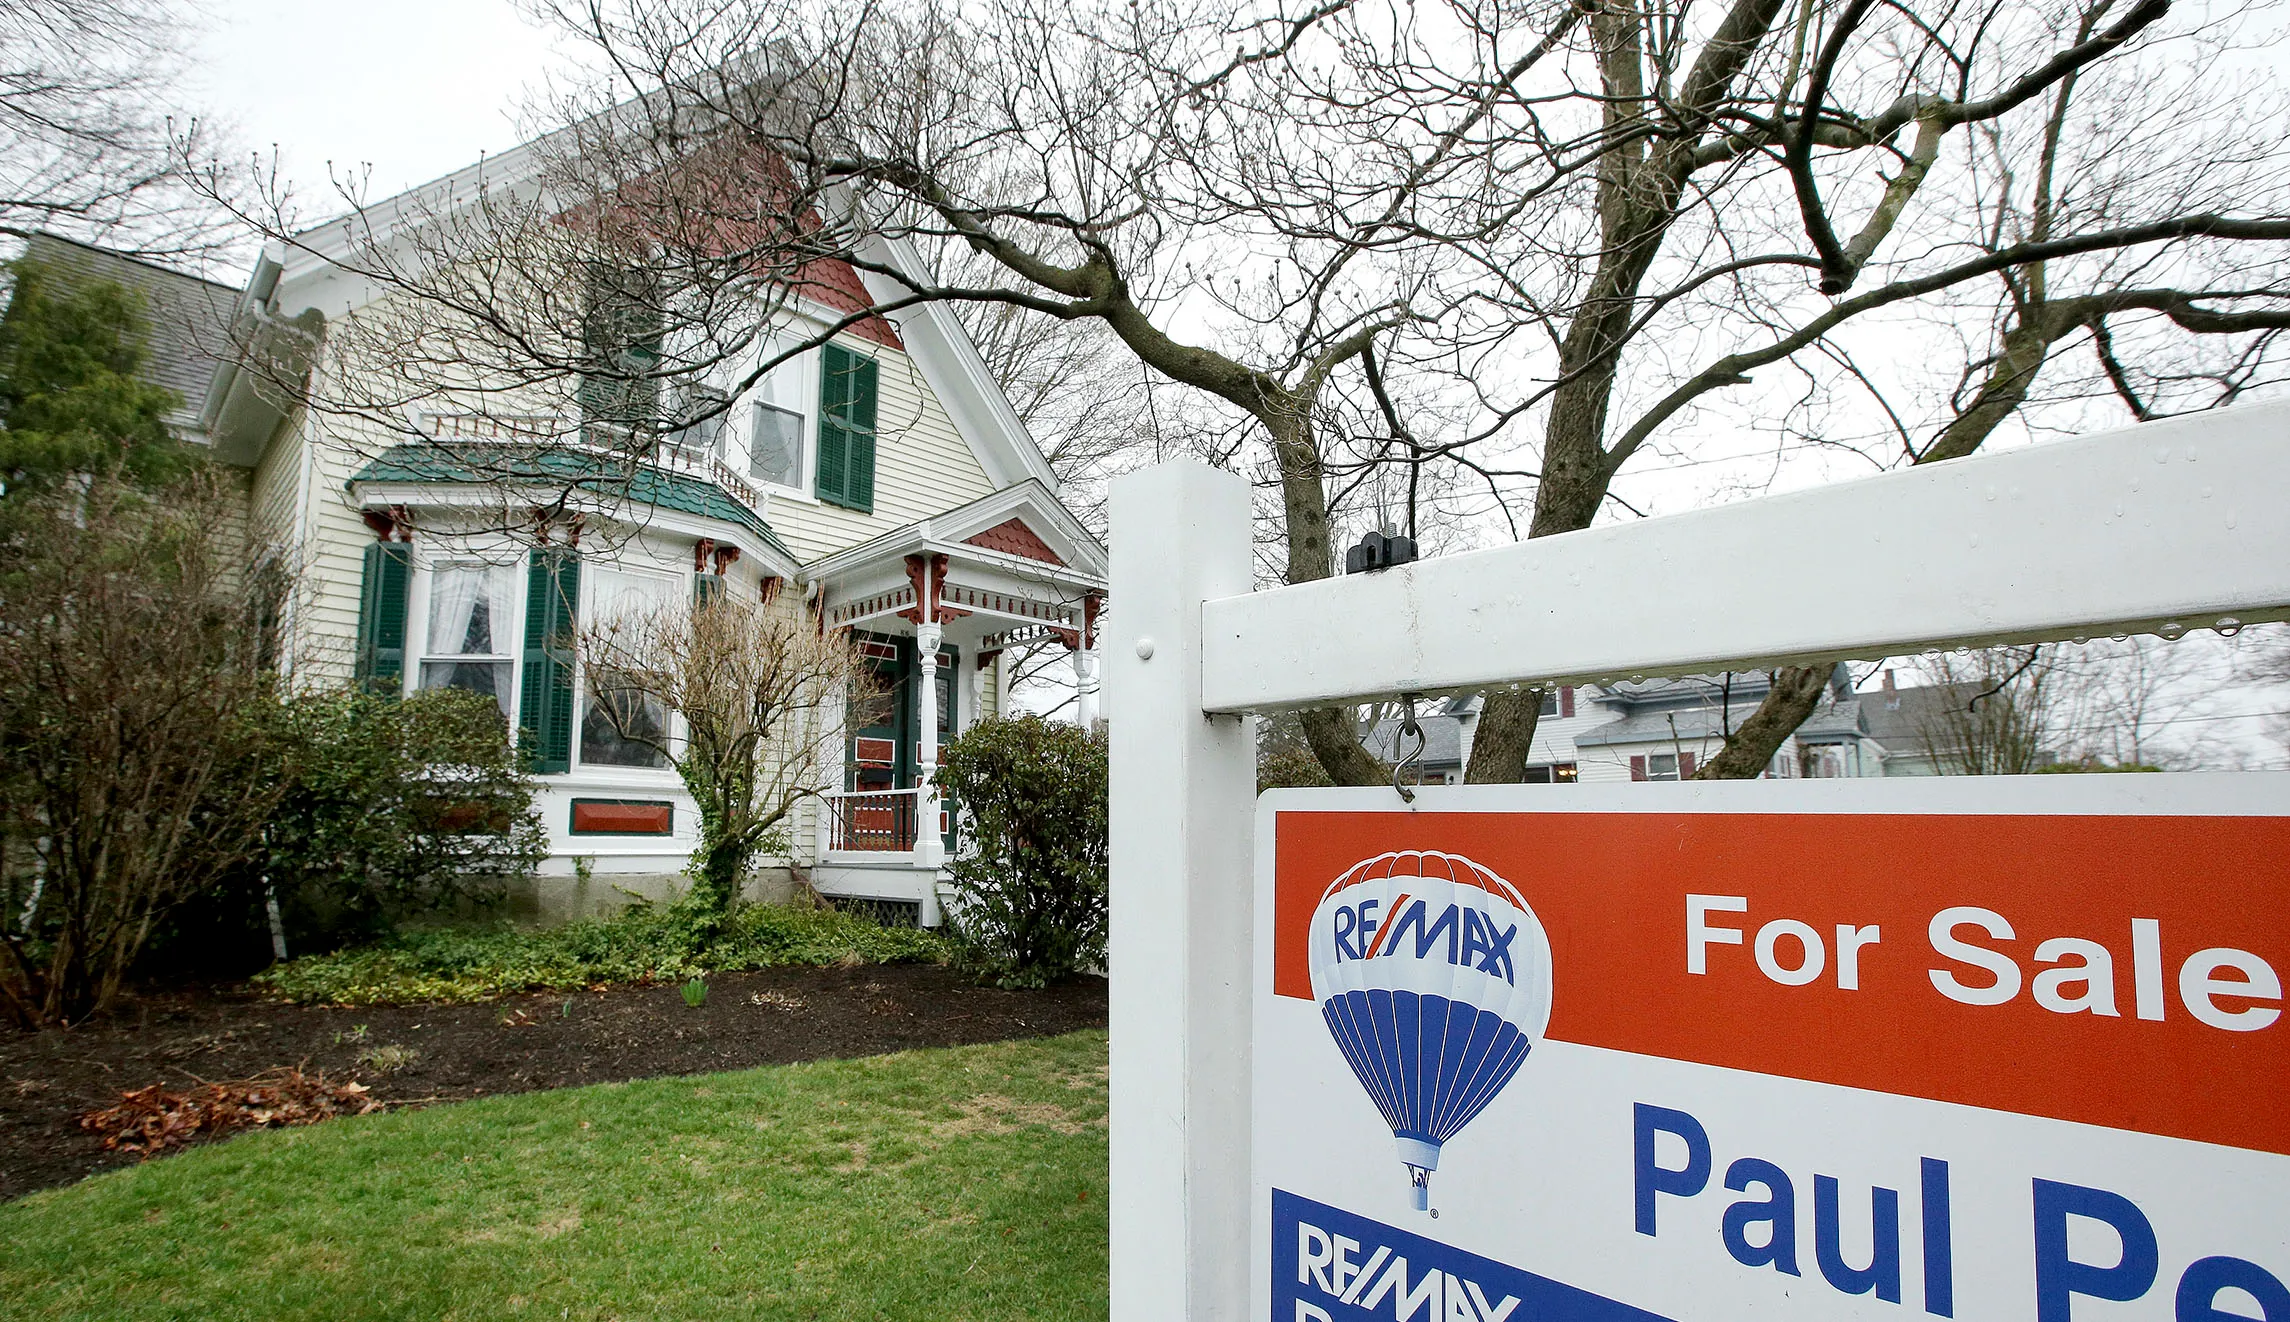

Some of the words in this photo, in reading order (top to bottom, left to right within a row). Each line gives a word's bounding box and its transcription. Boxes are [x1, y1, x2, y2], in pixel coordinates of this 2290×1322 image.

[1334, 893, 1518, 988] RE/MAX
[1686, 894, 1881, 991] For
[1929, 907, 2283, 1032] Sale
[1634, 1102, 1954, 1320] Paul
